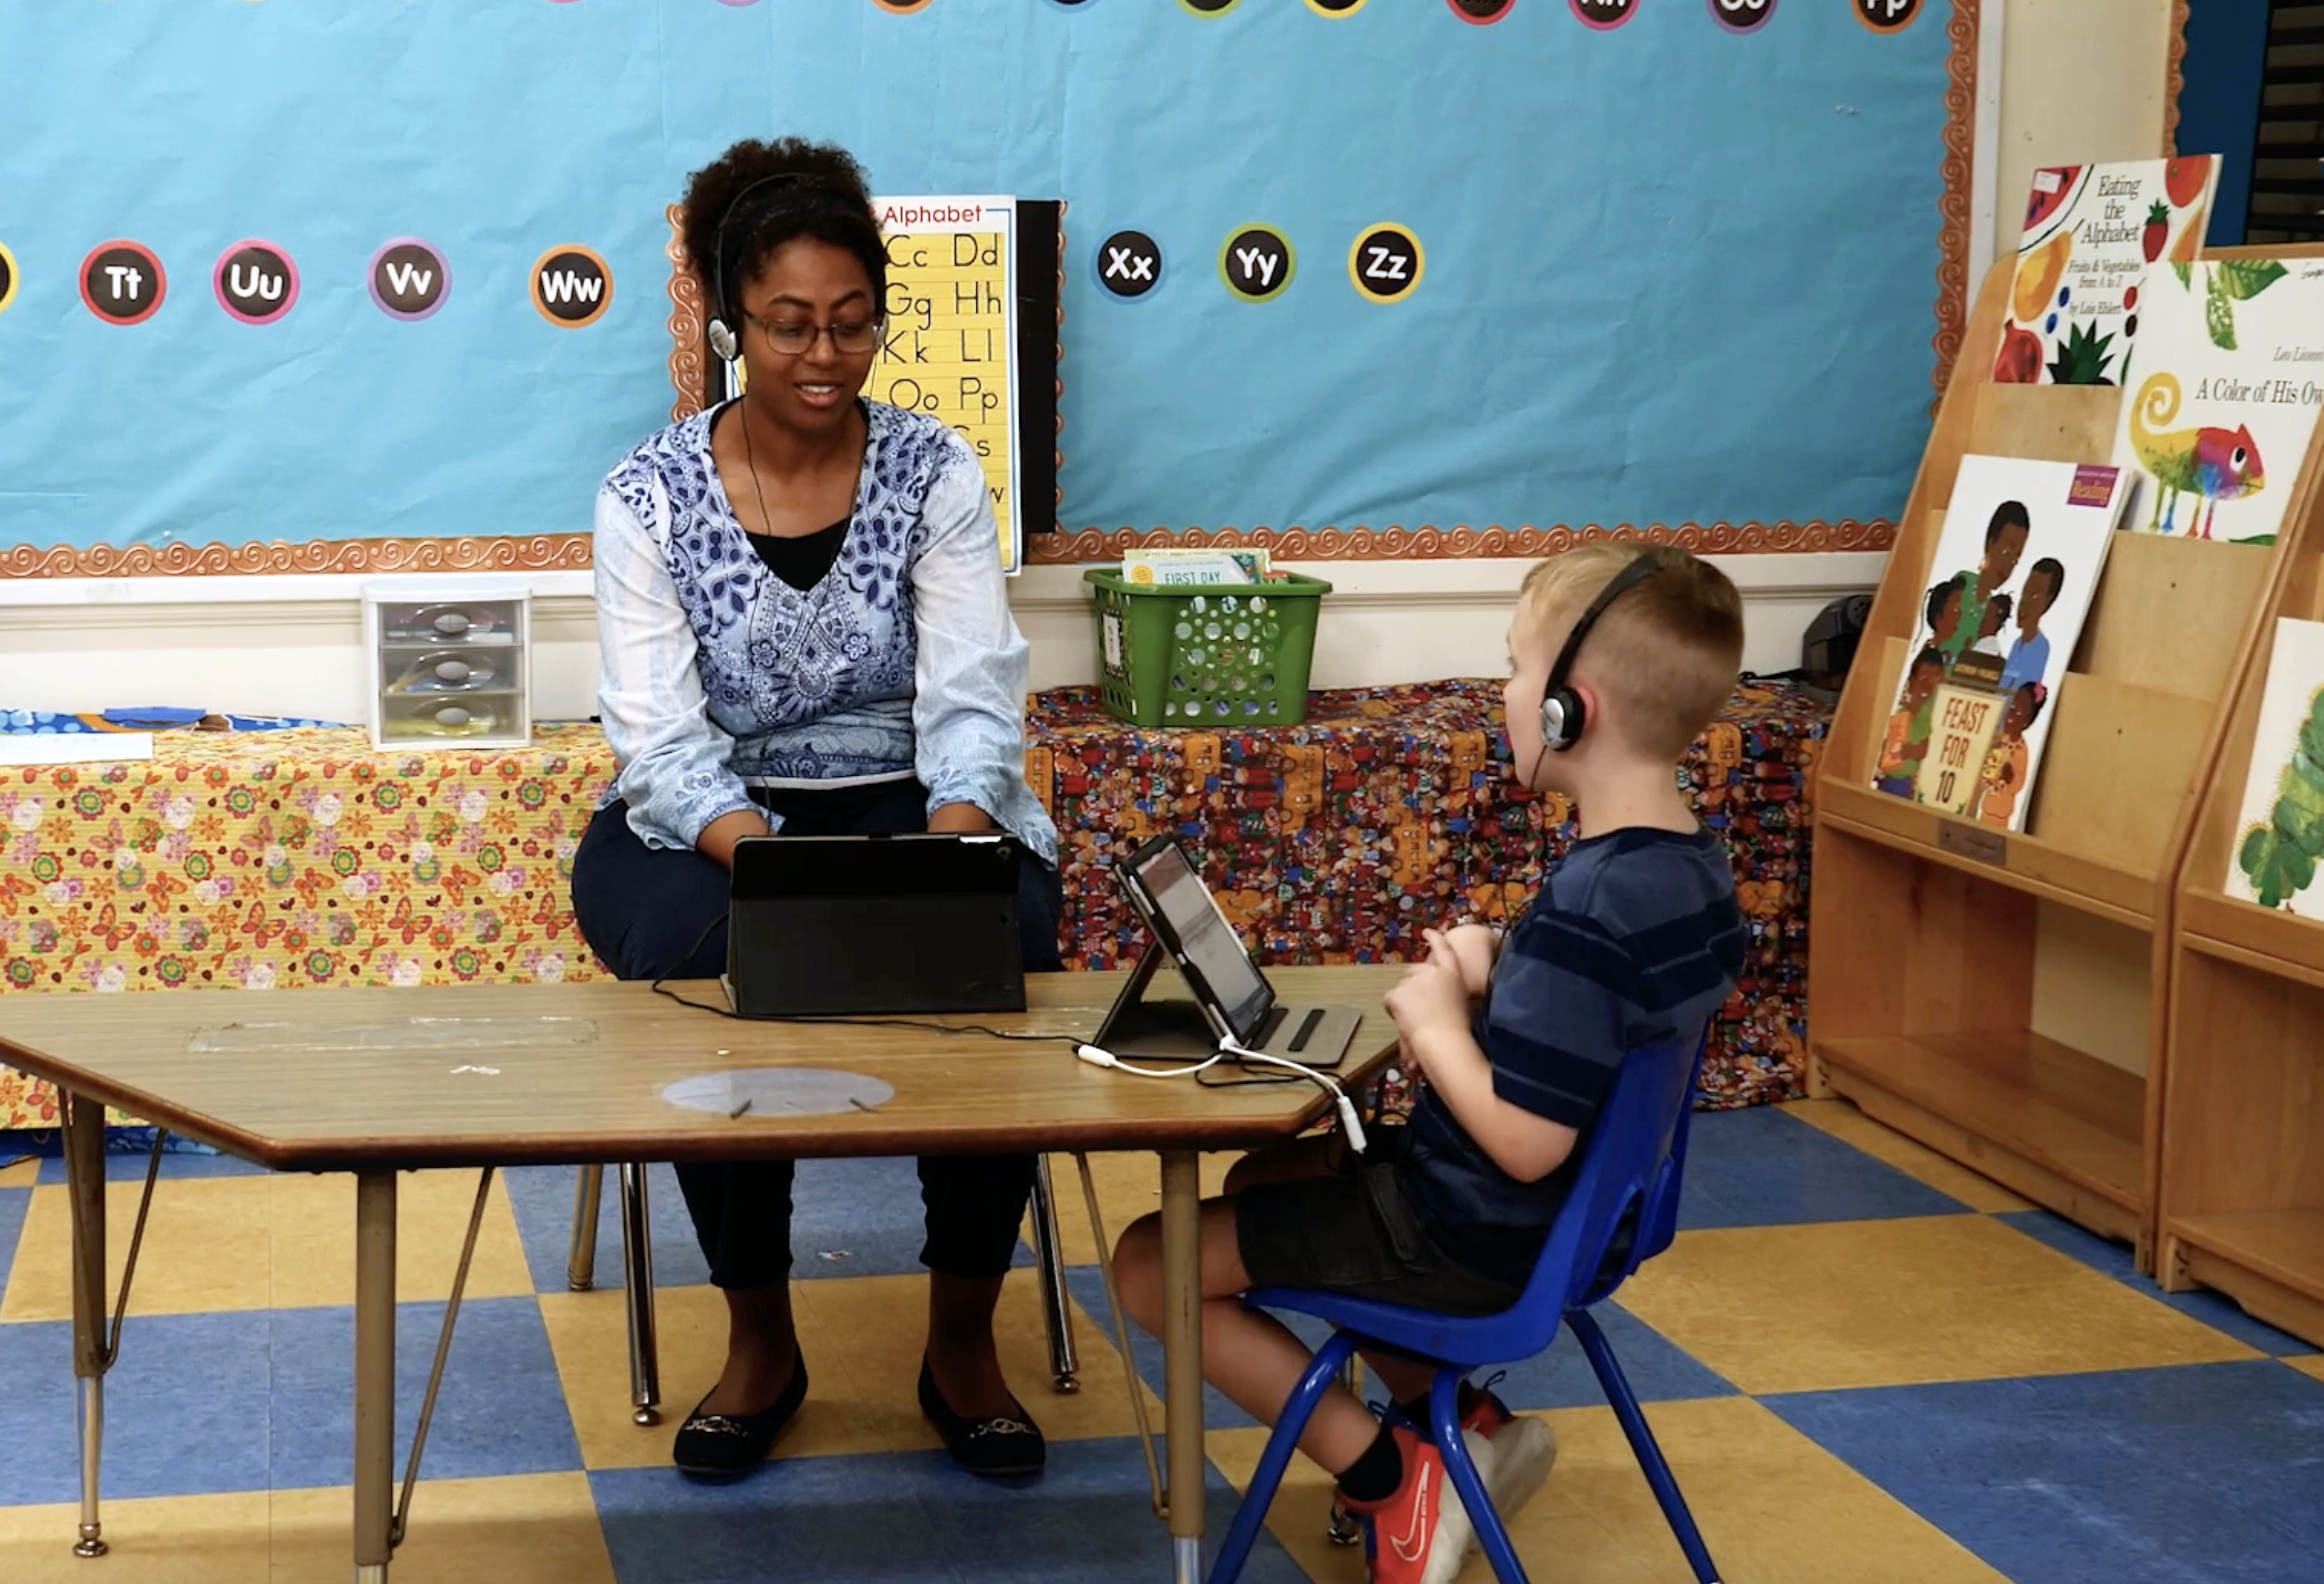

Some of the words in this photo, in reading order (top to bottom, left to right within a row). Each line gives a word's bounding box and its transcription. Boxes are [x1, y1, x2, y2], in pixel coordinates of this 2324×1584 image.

[2097, 174, 2142, 200] Eating
[883, 205, 982, 227] Alphabet
[2105, 199, 2126, 219] the
[885, 234, 928, 268] Cc
[953, 233, 998, 267] Dd
[2081, 221, 2139, 249] Alphabet
[386, 263, 432, 296] Vv
[1105, 247, 1153, 280] Xx
[1236, 248, 1278, 287] Yy
[1366, 247, 1407, 280] Zz
[105, 266, 142, 300] Tt
[230, 264, 283, 300] Uu
[541, 270, 603, 303] Ww
[884, 282, 931, 331] Gg
[955, 281, 1001, 314] Hh
[883, 330, 929, 364] Kk
[889, 379, 939, 411] Oo
[960, 377, 998, 424] Pp
[2195, 378, 2208, 400] A
[2213, 377, 2251, 401] Color
[2252, 379, 2272, 402] of
[2270, 380, 2298, 404] His
[1165, 573, 1196, 585] FIRST
[1200, 571, 1221, 584] DAY
[1942, 697, 1990, 735] FEAST
[1939, 734, 1970, 770] FOR
[1935, 769, 1956, 803] 10
